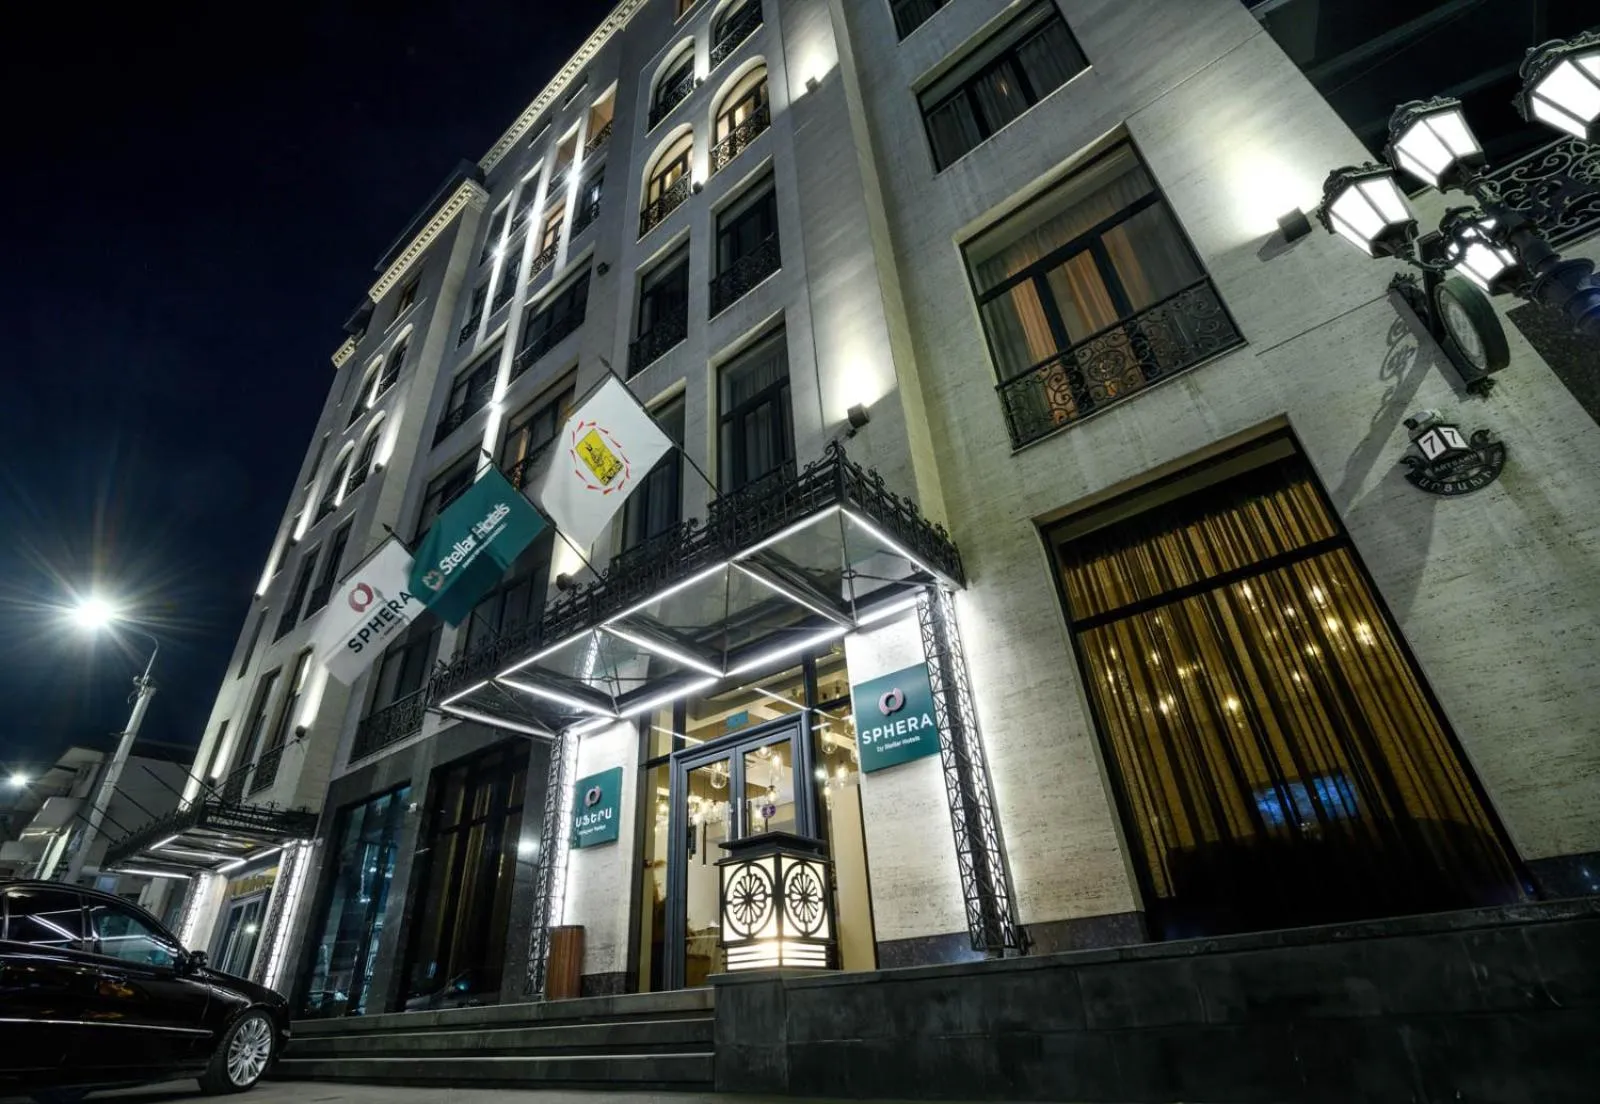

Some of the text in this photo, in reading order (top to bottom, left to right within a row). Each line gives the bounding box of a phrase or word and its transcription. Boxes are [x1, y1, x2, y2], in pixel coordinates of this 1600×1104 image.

[439, 533, 477, 575] Stellar
[471, 503, 511, 540] Hotels
[347, 591, 413, 653] SPHERA
[862, 713, 933, 745] SPHERA
